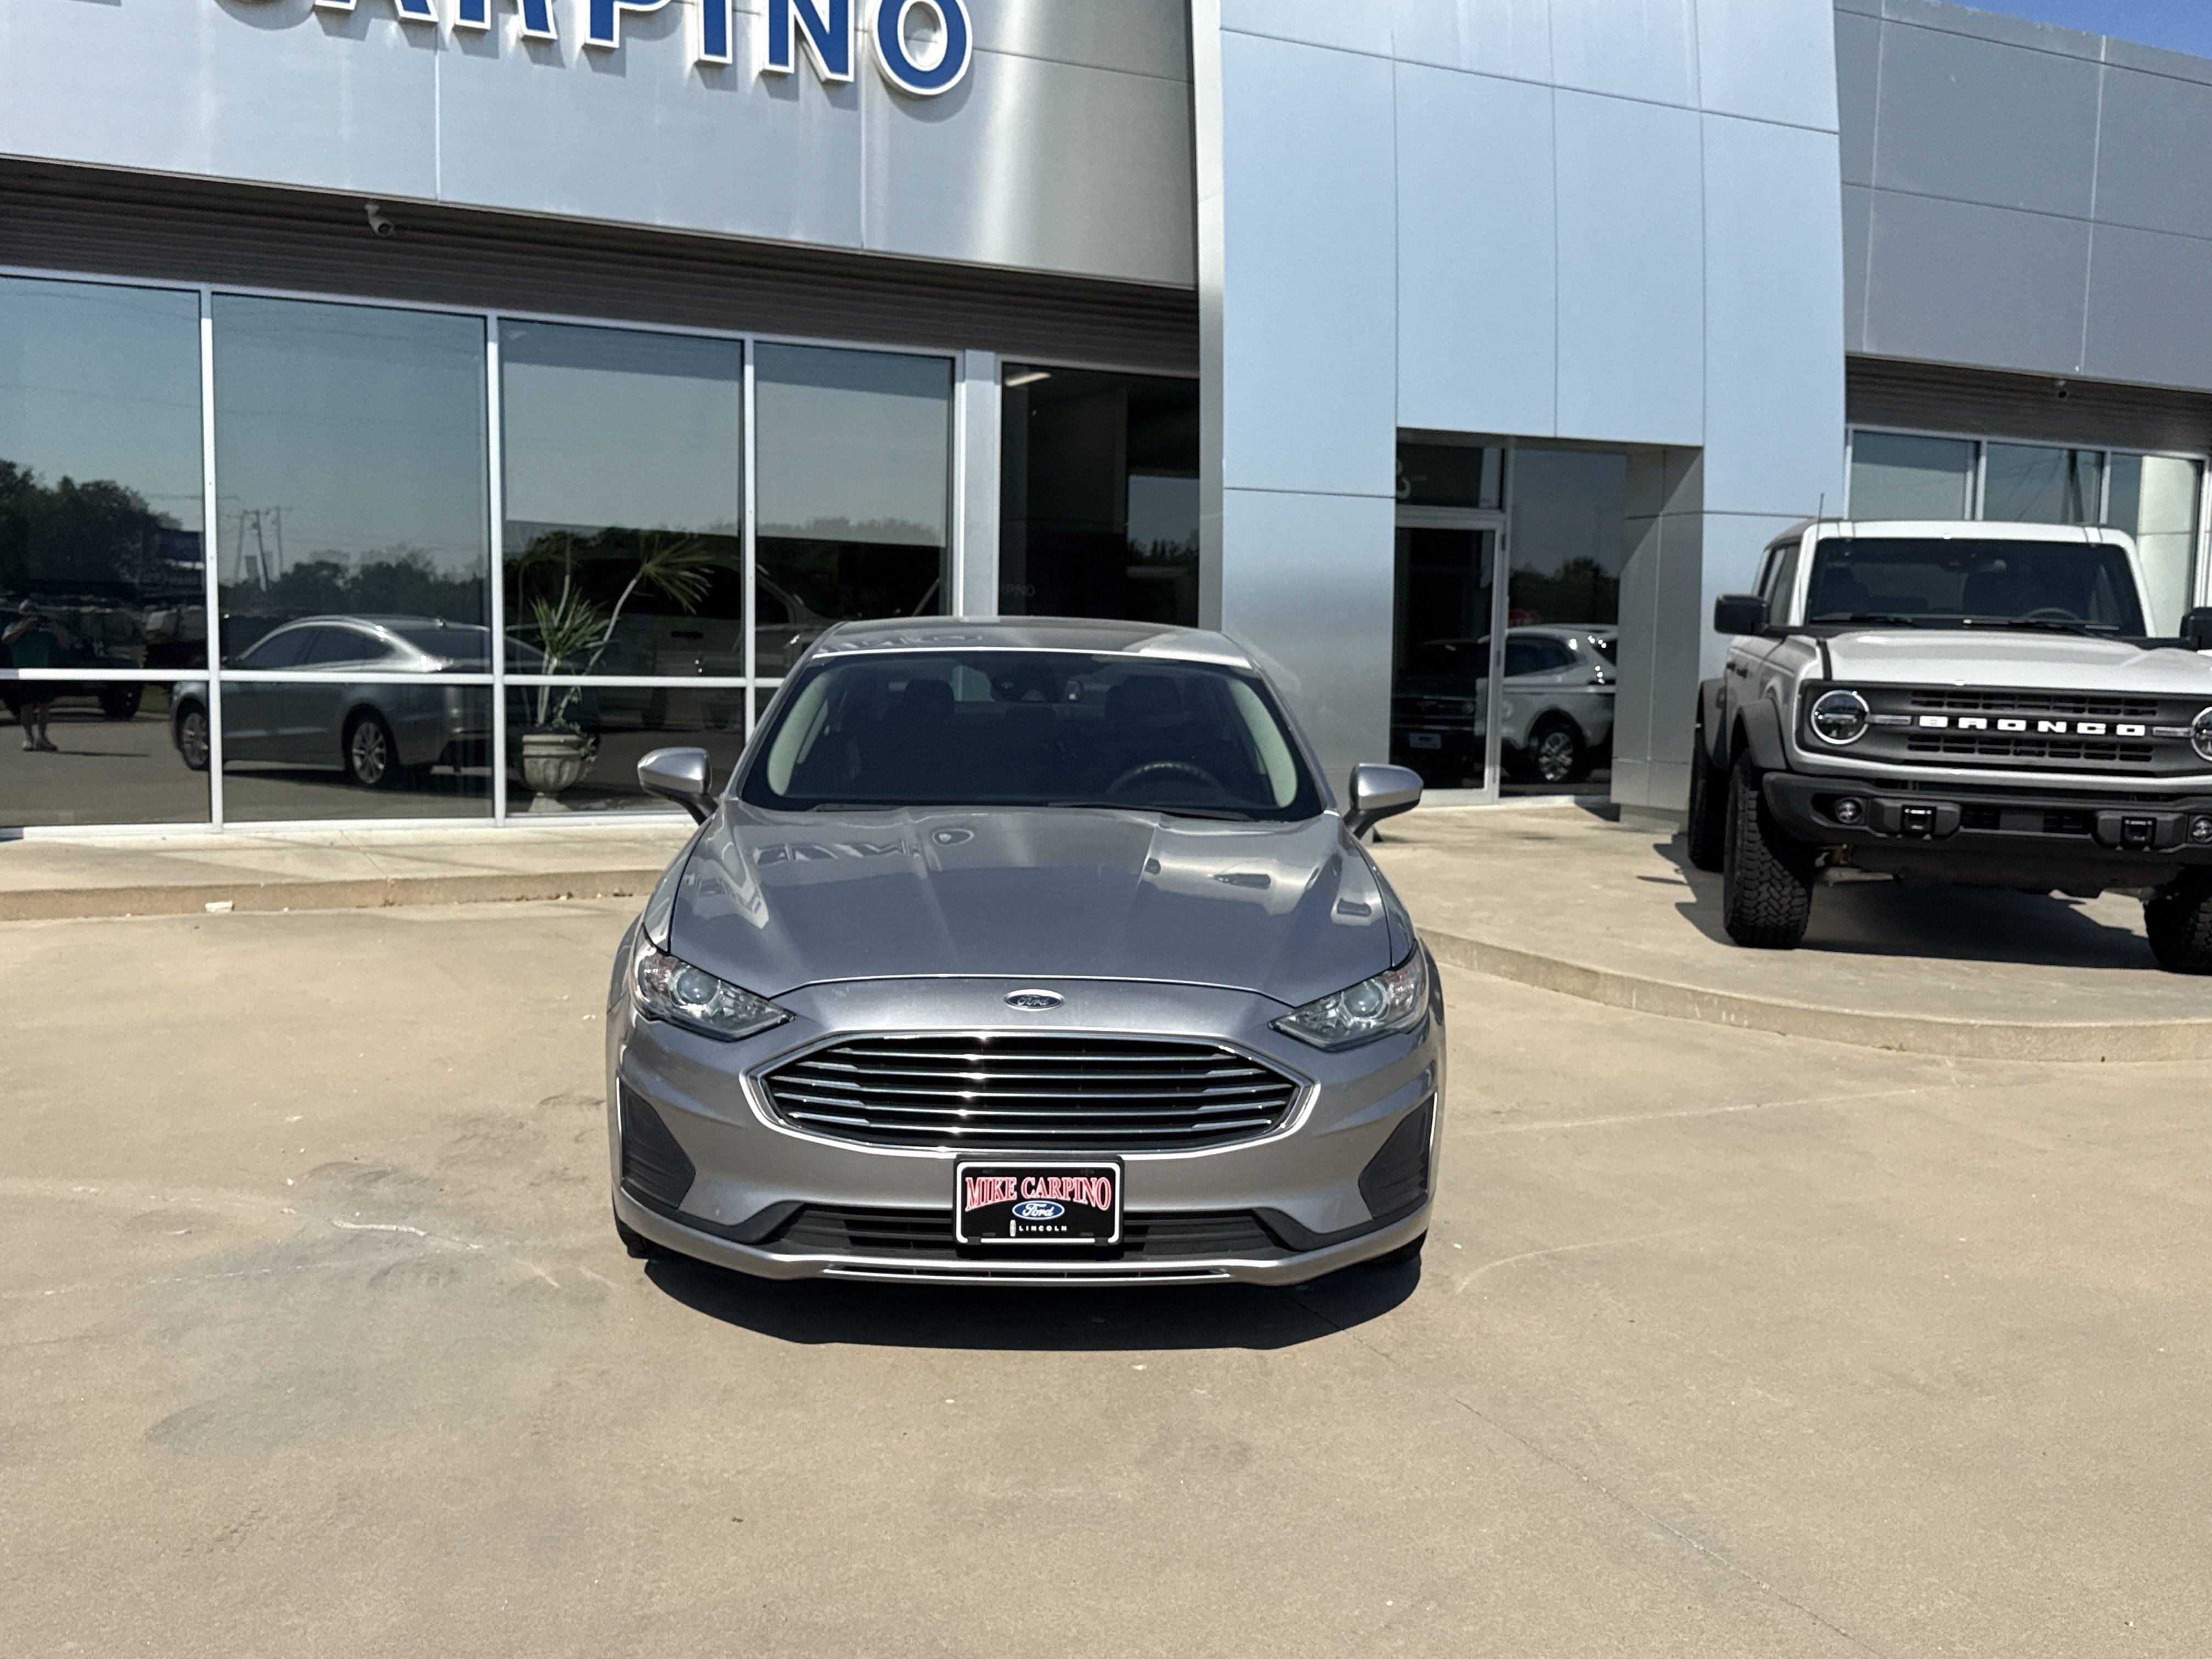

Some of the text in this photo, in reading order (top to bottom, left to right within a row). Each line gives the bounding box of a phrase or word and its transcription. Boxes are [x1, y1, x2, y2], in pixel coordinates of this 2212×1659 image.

[1920, 715, 2146, 737] BRONCO
[1017, 995, 1049, 1006] Ford
[965, 1177, 1112, 1212] MIKE CARPINO
[1022, 1203, 1054, 1217] Ford
